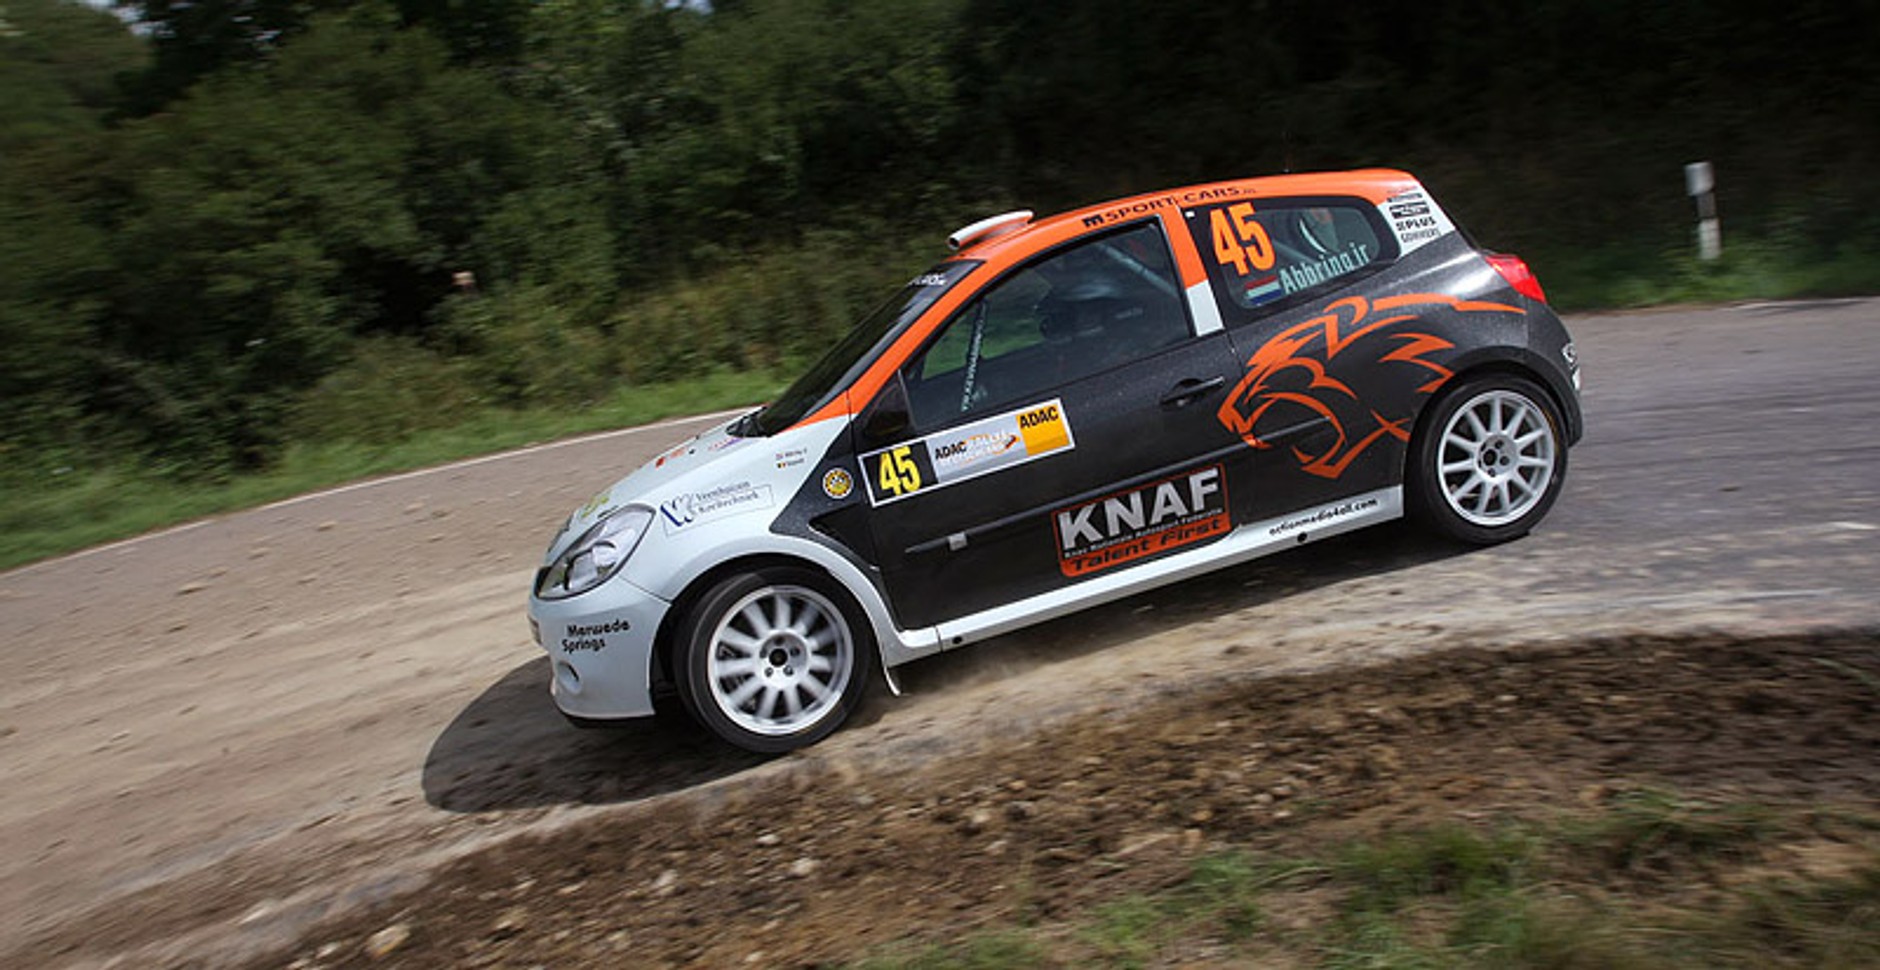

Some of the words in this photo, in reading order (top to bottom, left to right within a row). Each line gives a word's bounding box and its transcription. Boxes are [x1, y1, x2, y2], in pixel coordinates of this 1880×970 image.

[1209, 201, 1276, 276] 45
[1019, 407, 1059, 429] ADAC
[934, 440, 967, 460] ADAC
[878, 445, 922, 496] 45
[1057, 467, 1219, 549] KNAF
[1073, 539, 1150, 571] Talent
[1159, 519, 1220, 546] First
[566, 618, 630, 637] Merwede
[561, 638, 606, 655] Springs
